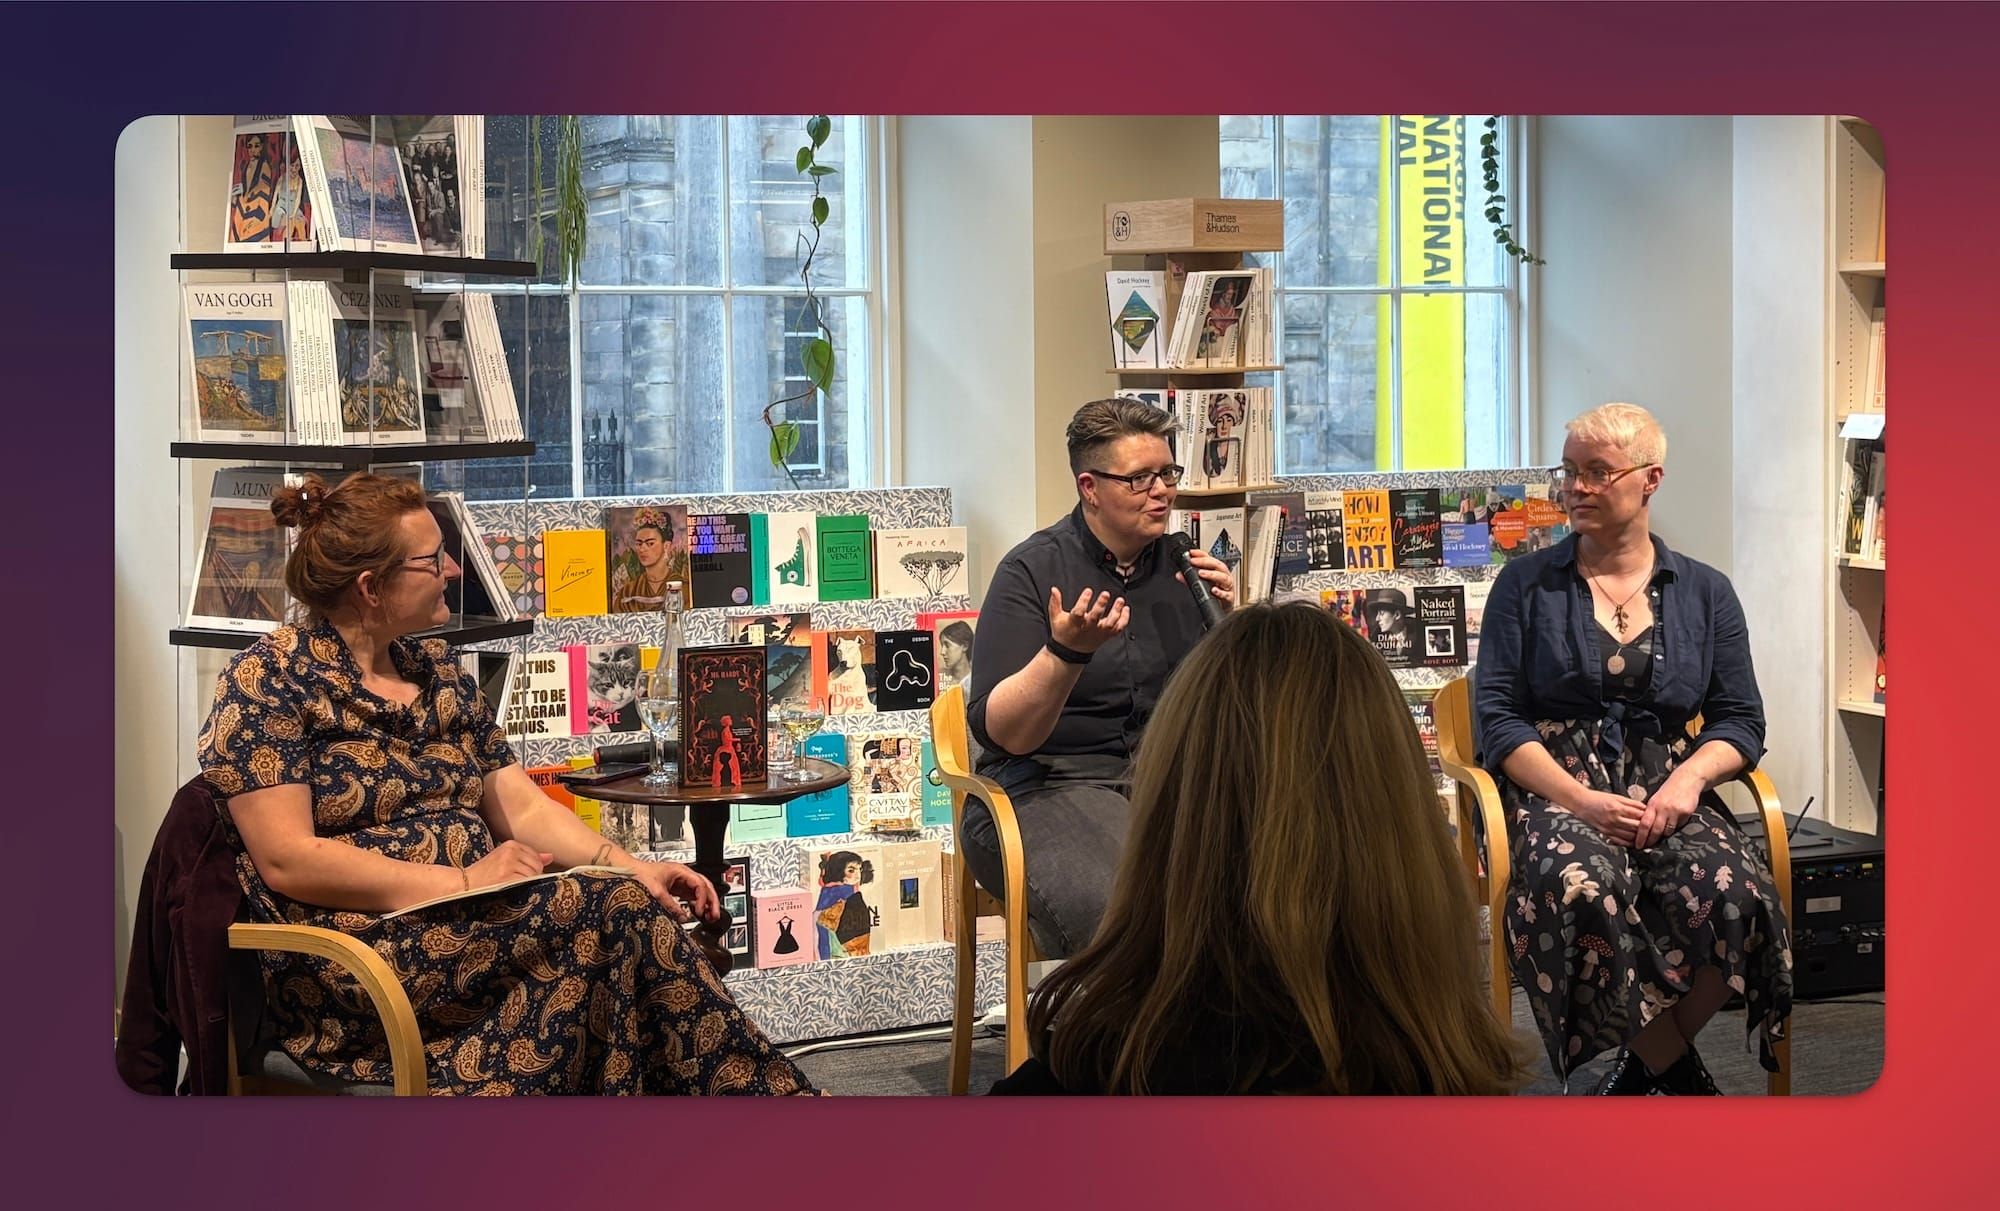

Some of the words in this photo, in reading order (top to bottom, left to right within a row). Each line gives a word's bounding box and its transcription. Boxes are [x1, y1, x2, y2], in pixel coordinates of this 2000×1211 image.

[1206, 212, 1237, 223] Thames
[1206, 223, 1240, 233] &Hudson
[195, 293, 226, 307] VAN
[228, 292, 273, 307] GOGH
[1345, 496, 1379, 515] HOW
[1527, 503, 1554, 513] Circles
[708, 515, 726, 525] THIS
[1527, 513, 1558, 522] Squares
[696, 525, 712, 535] YOU
[712, 525, 736, 534] WANT
[1345, 526, 1387, 543] ENJOY
[688, 535, 698, 545] TO
[699, 534, 720, 545] TAKE
[720, 533, 746, 544] GREAT
[897, 539, 947, 548] AFRICA
[827, 545, 861, 554] BOTTEGA
[1459, 543, 1486, 552] Hockney
[830, 552, 858, 561] VENETA
[1347, 545, 1386, 569] ART
[1420, 597, 1455, 609] Naked
[1420, 608, 1456, 618] Portrait
[525, 659, 556, 674] THIS
[938, 673, 952, 682] The
[832, 683, 851, 693] The
[532, 690, 548, 704] TO
[550, 688, 566, 702] BE
[832, 694, 864, 711] Dog
[591, 710, 621, 725] Cat
[505, 720, 549, 735] MOUS.
[869, 805, 908, 814] KLIMT
